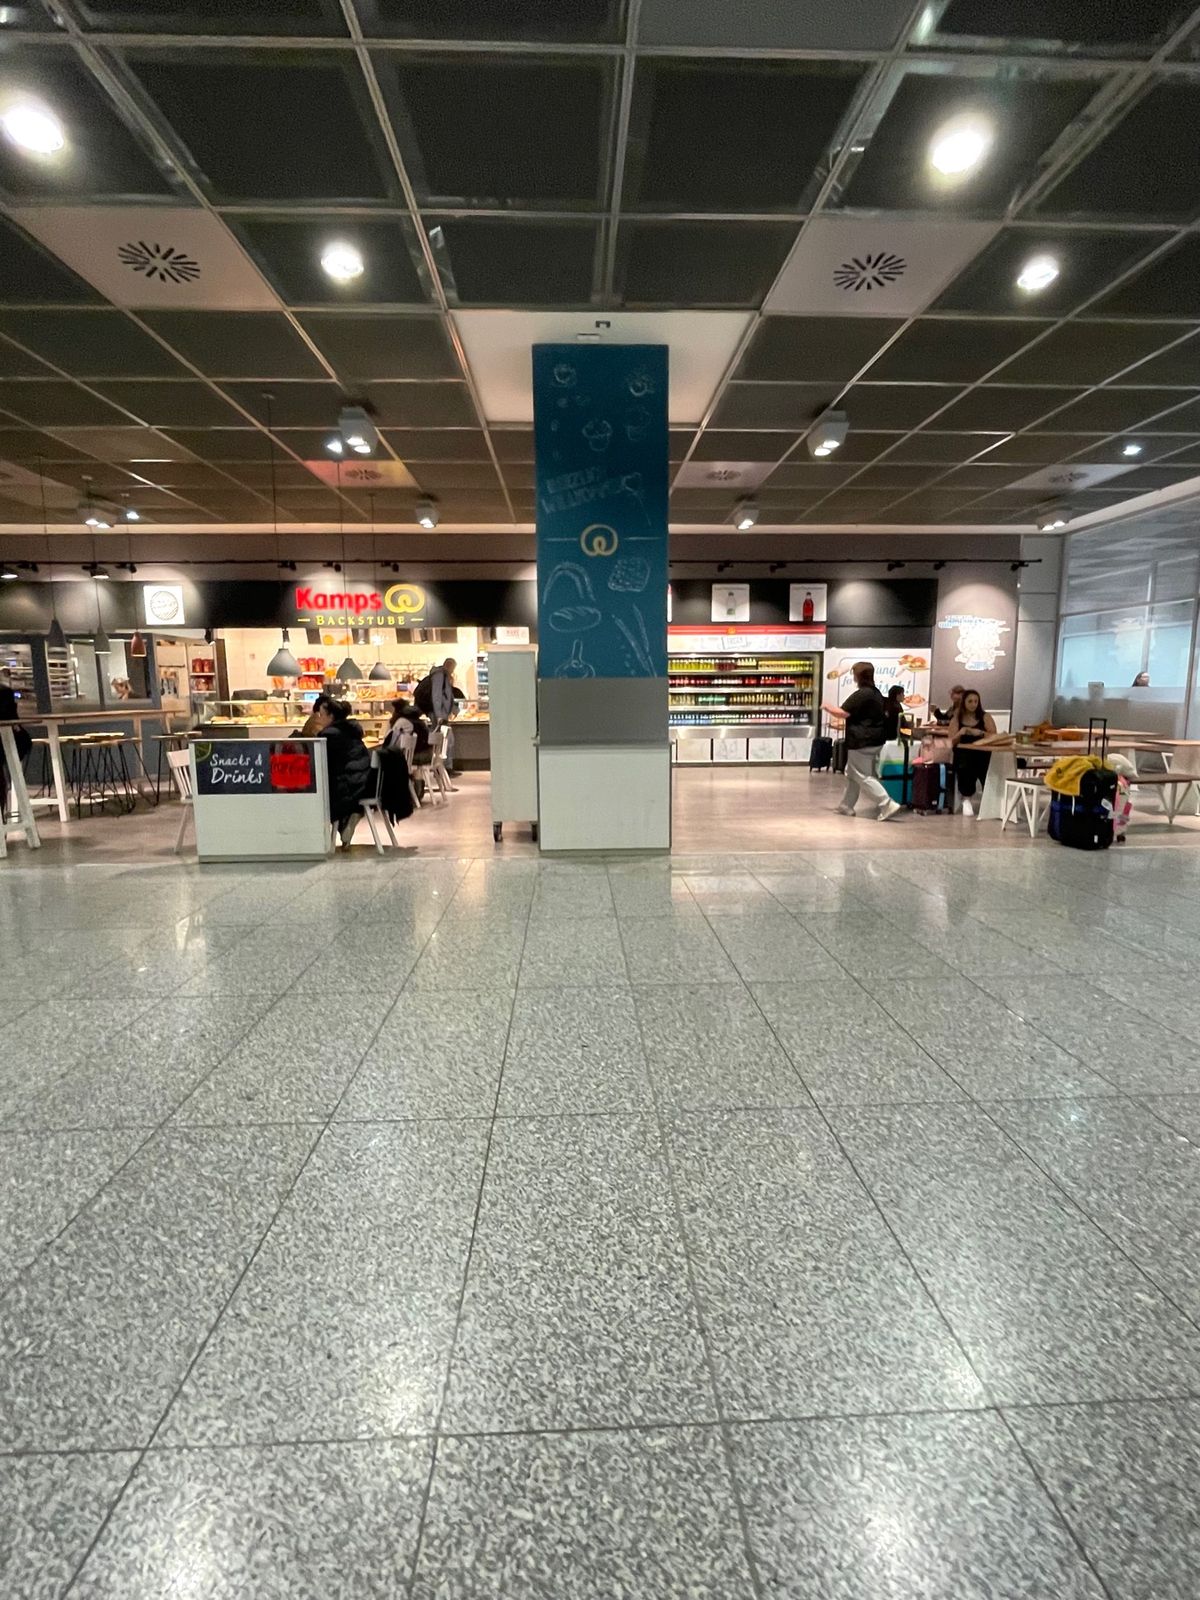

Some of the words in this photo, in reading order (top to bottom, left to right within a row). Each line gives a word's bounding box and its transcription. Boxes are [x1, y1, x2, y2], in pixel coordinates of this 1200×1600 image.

[296, 587, 383, 615] Kamps
[316, 615, 406, 626] BACKSTUBE
[210, 753, 251, 767] Snacks
[255, 753, 263, 766] &
[211, 767, 264, 784] Drinks
